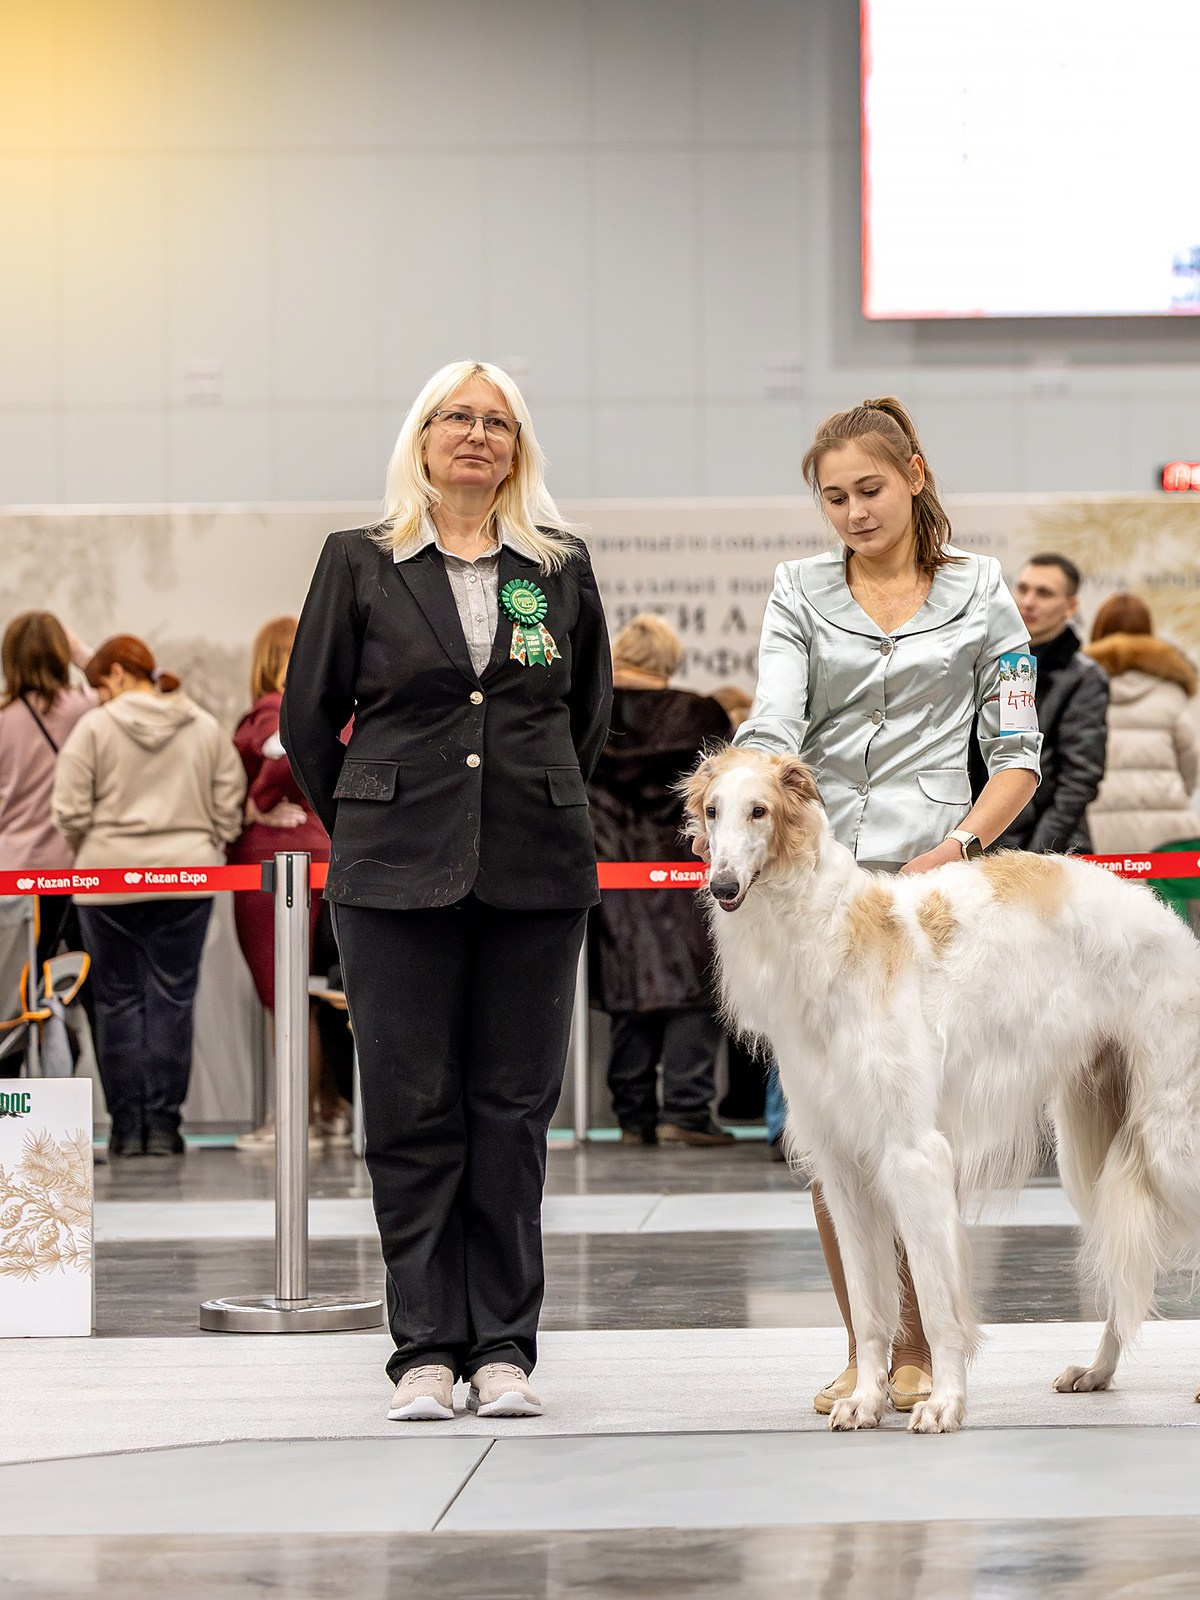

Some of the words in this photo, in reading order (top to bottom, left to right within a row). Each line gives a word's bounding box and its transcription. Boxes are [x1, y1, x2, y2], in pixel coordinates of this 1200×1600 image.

[1124, 859, 1151, 872] Expo
[37, 877, 70, 889] Kazan
[72, 875, 100, 889] Expo
[145, 872, 178, 883] Kazan
[180, 871, 207, 886] Expo
[670, 870, 703, 882] Kazan
